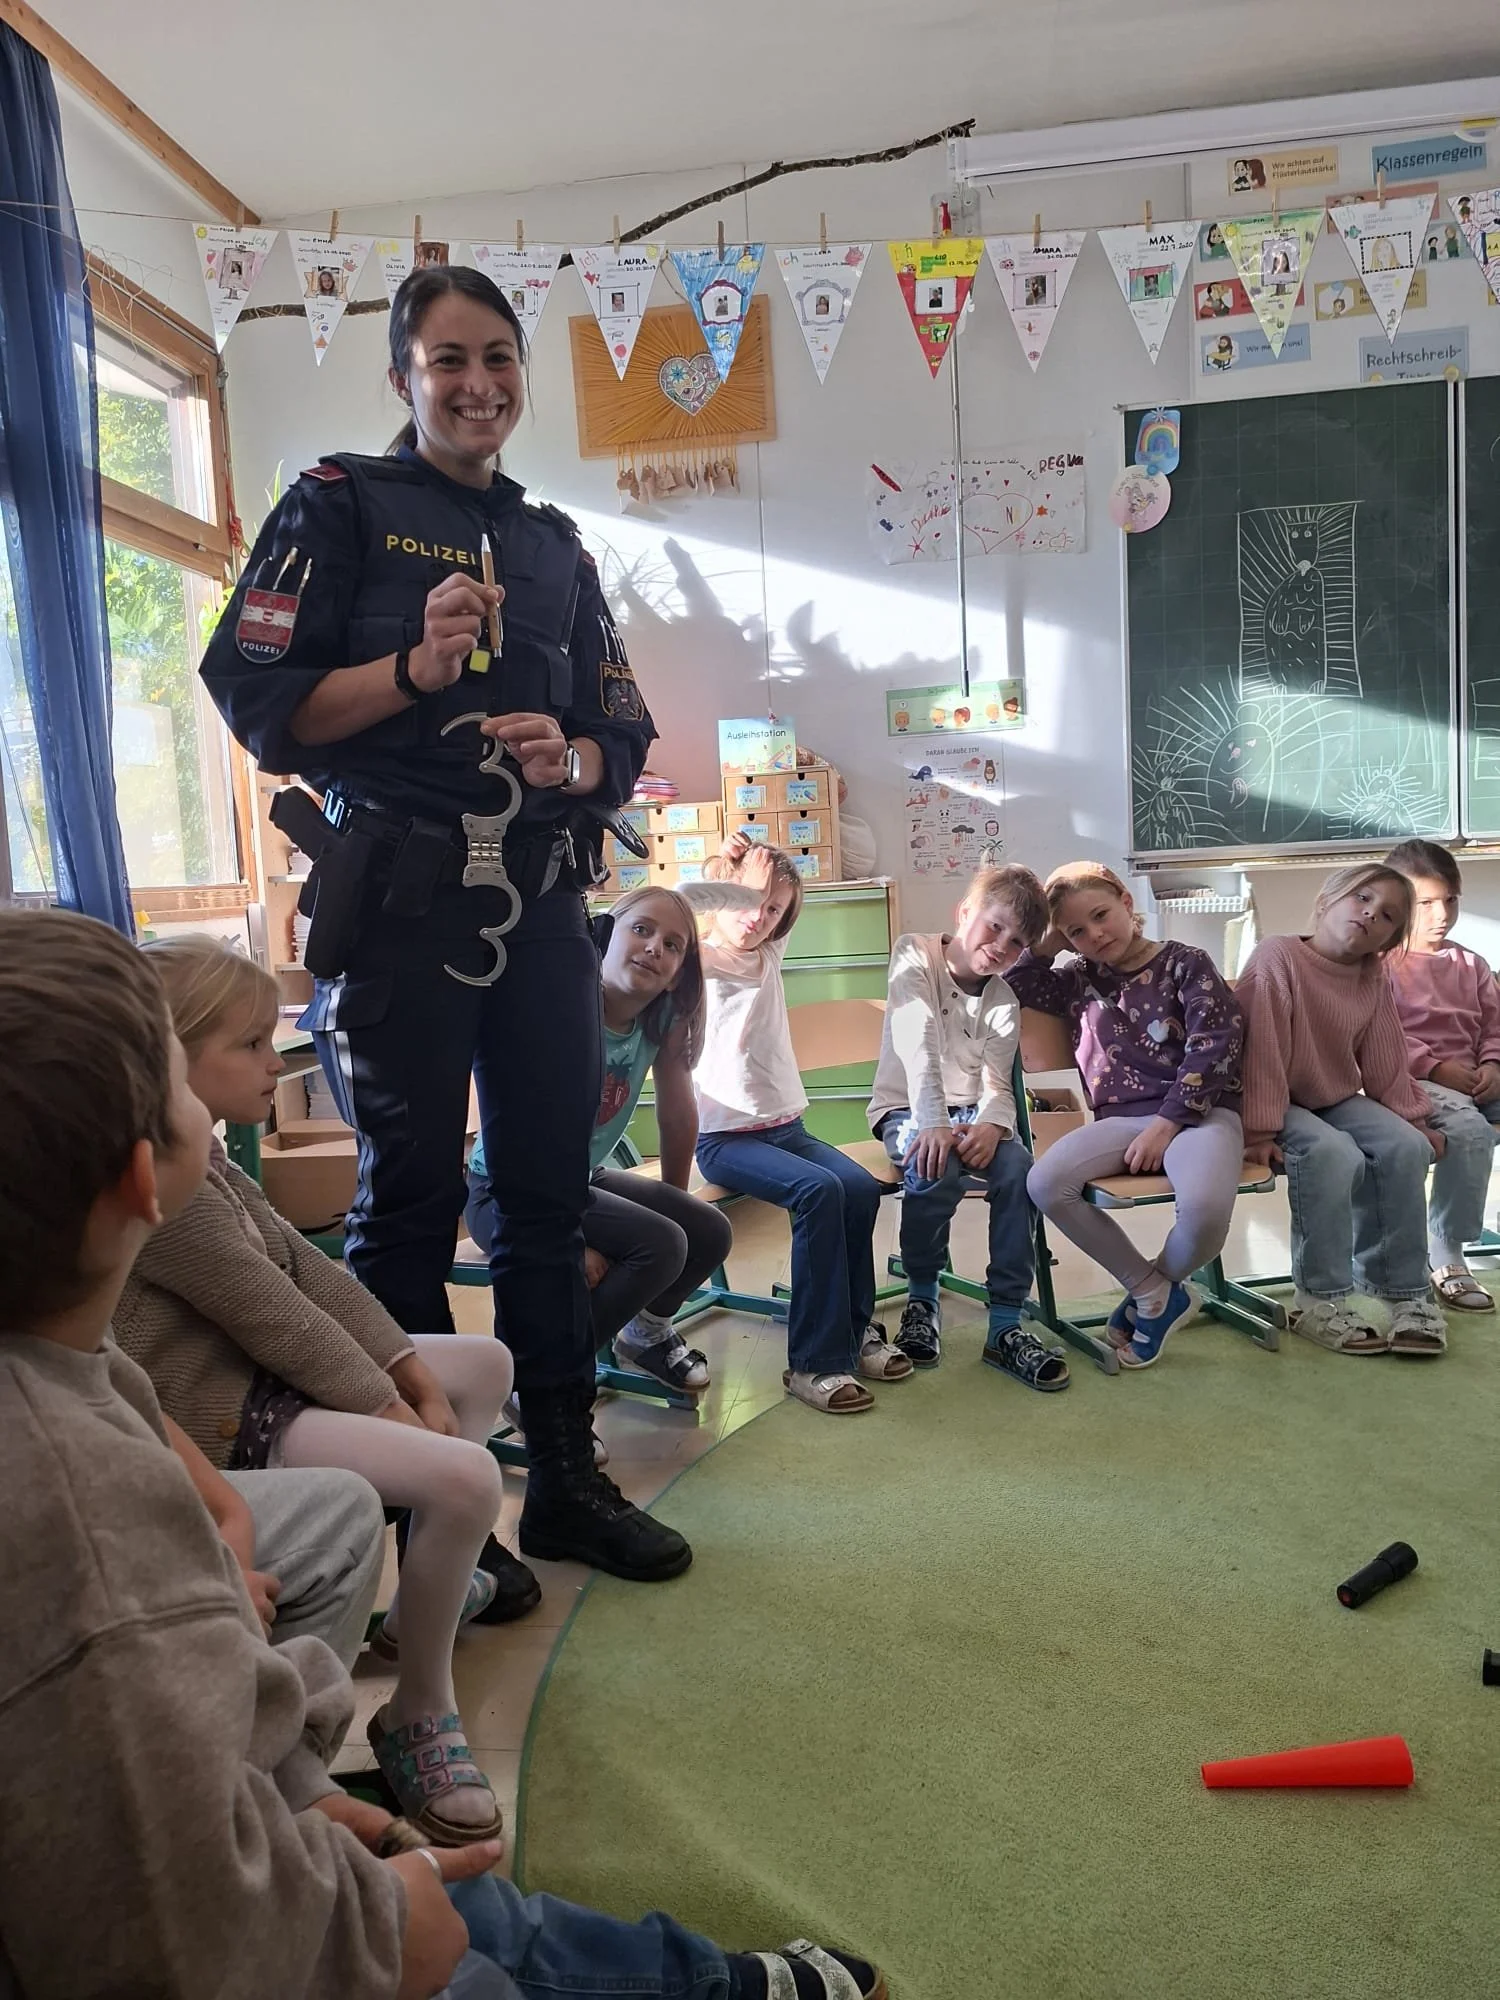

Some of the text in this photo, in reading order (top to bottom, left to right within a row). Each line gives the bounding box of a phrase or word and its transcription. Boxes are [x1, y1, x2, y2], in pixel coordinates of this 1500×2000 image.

[1271, 156, 1324, 170] Wir achten auf
[1376, 145, 1483, 172] Klassenregeln
[1149, 235, 1175, 246] MAX
[579, 250, 600, 269] Ich
[617, 258, 648, 267] LAURA
[1246, 338, 1303, 354] Wir men uns!
[1366, 345, 1462, 368] Rechtschreib-
[386, 534, 477, 565] POLIZEI
[242, 641, 280, 655] POLIZEI
[727, 729, 786, 740] Ausleihstation
